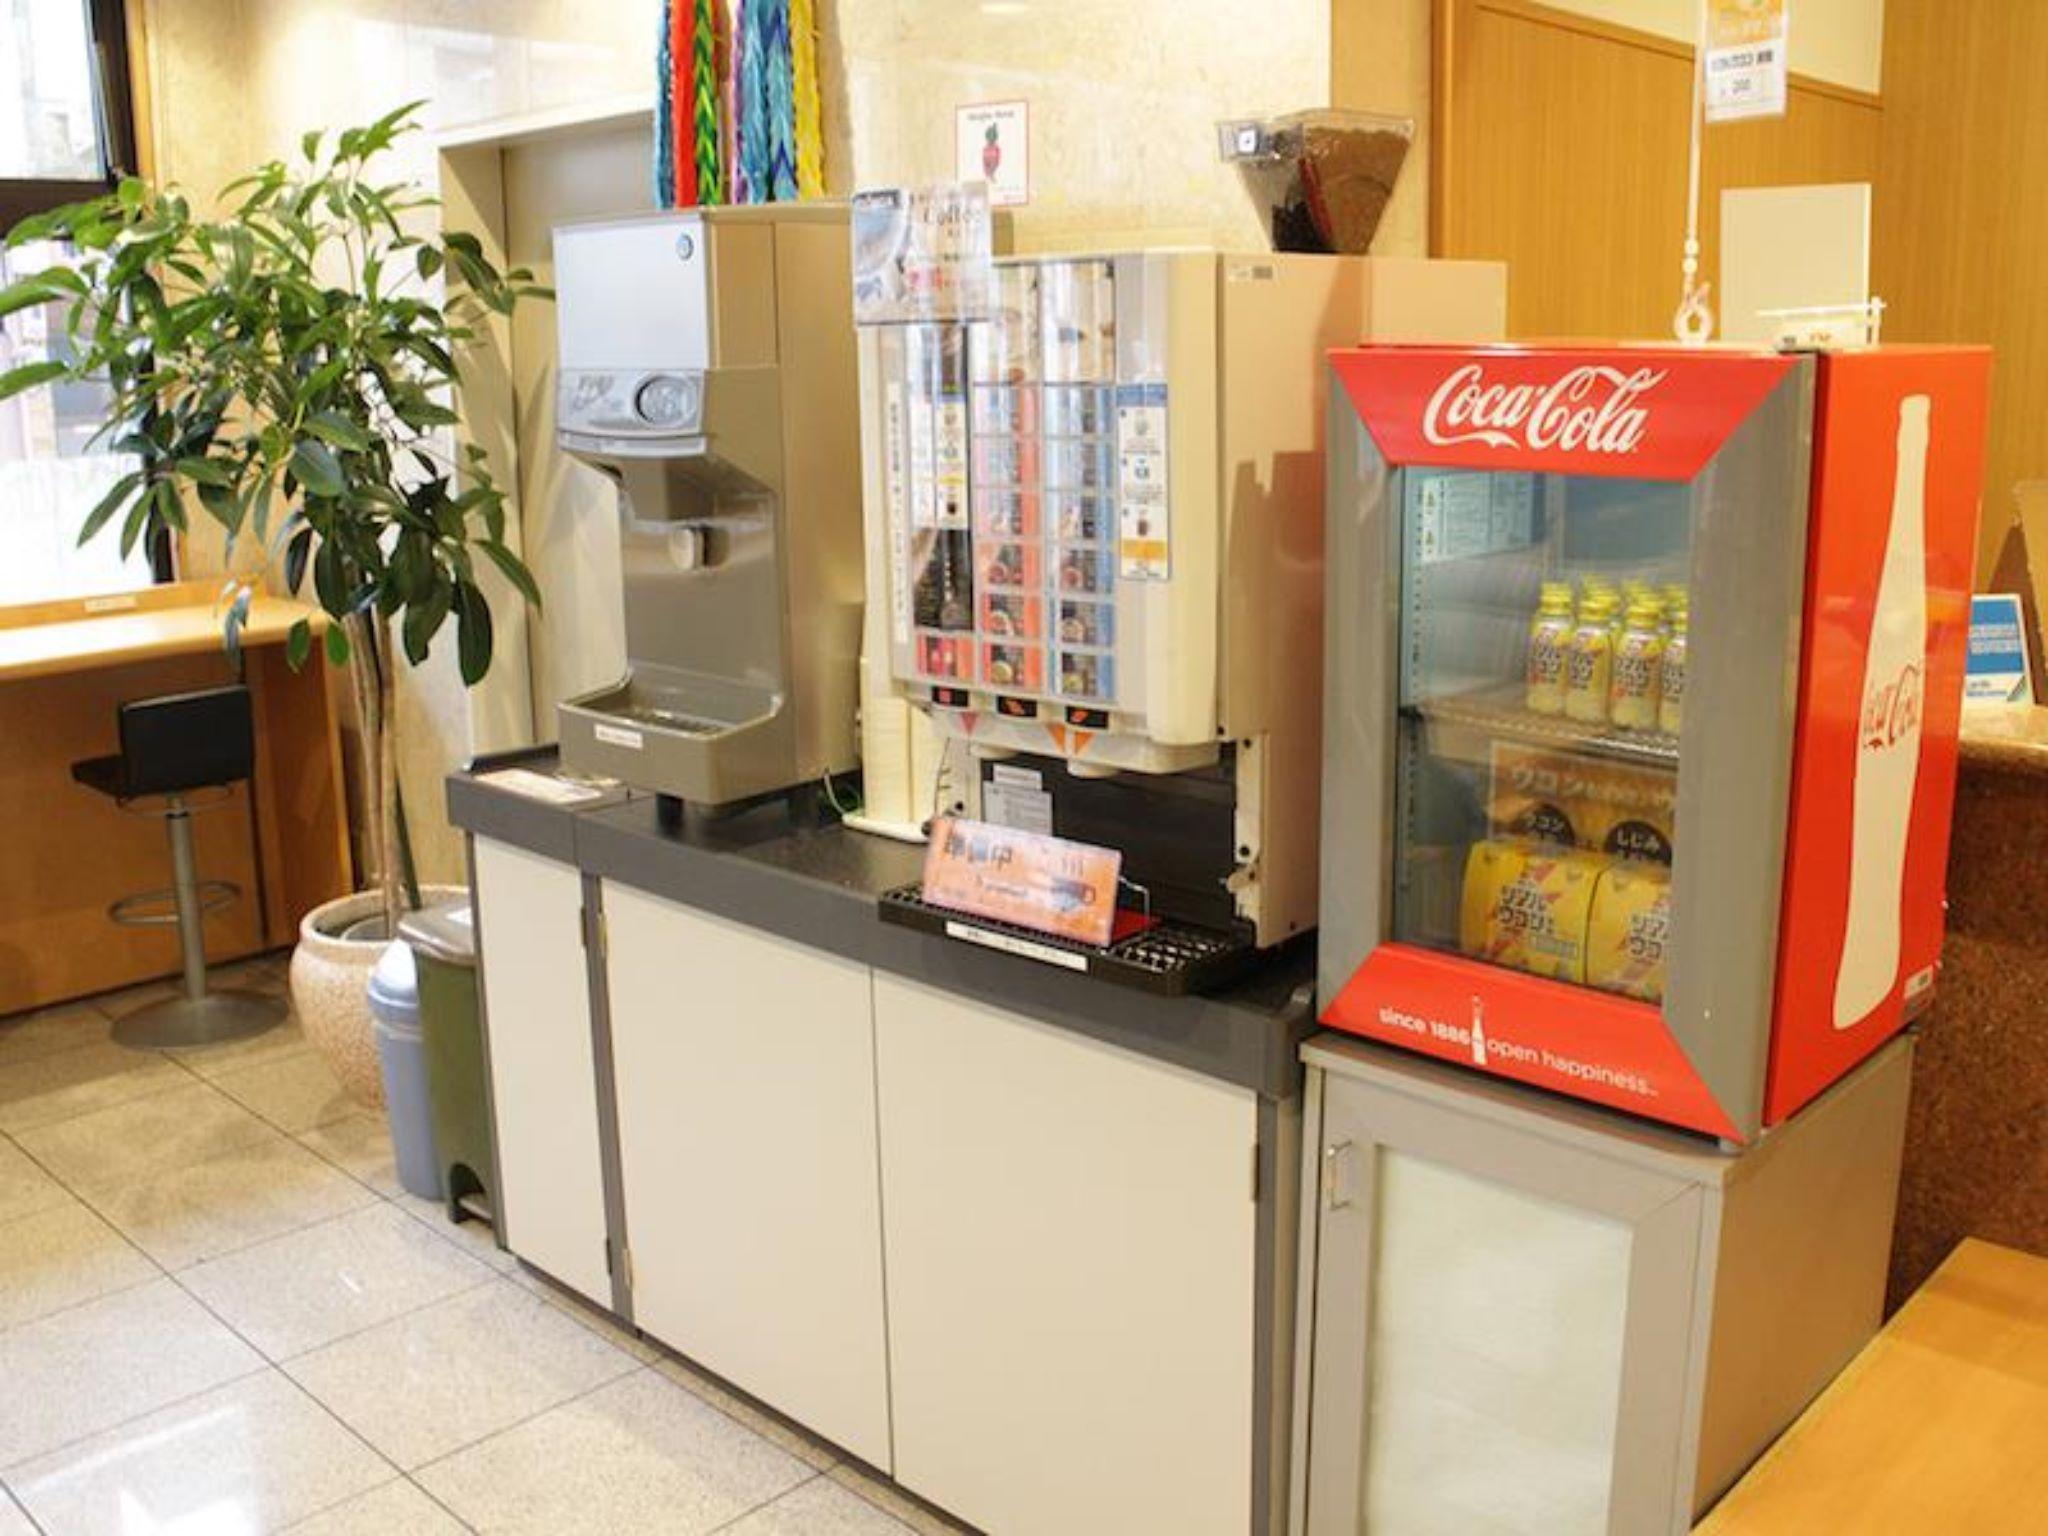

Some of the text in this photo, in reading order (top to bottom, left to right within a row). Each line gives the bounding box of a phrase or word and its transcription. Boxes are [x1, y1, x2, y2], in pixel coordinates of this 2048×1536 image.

[1423, 364, 1669, 453] Coca-Cola
[1379, 1006, 1427, 1034] since
[1430, 1020, 1471, 1046] 1886
[1486, 1038, 1539, 1063] open
